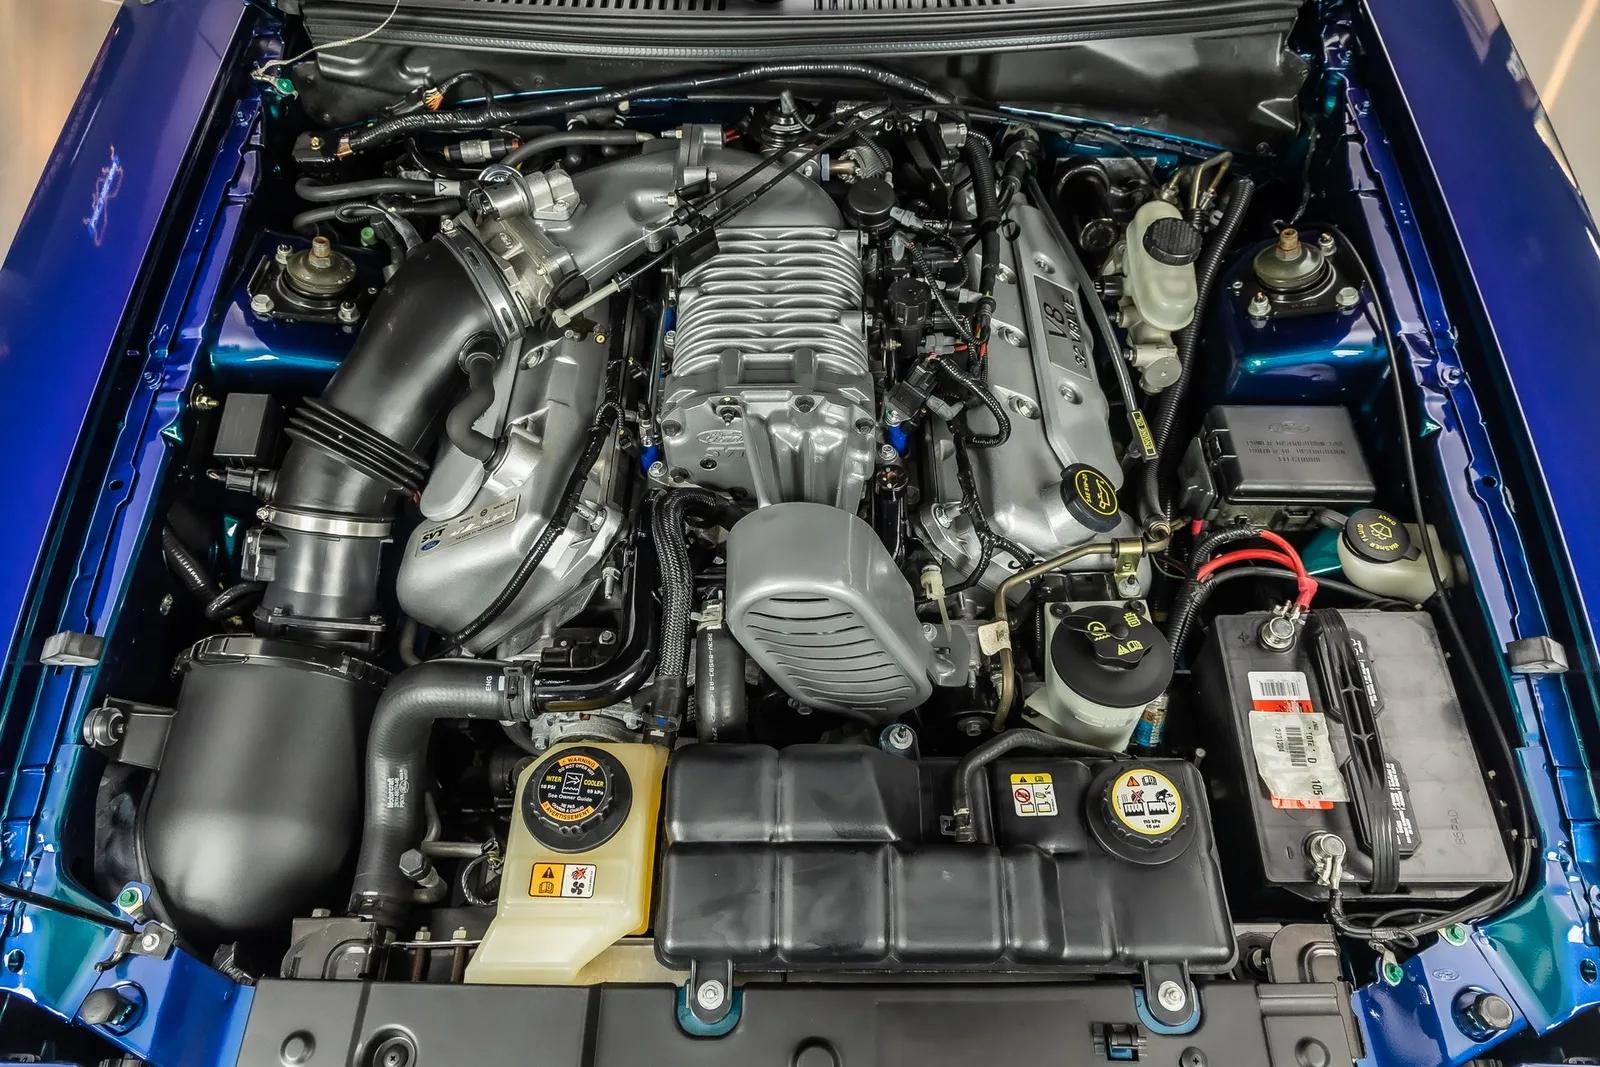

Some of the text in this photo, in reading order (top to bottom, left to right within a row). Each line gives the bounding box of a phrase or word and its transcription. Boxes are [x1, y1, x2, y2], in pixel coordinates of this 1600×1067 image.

[1043, 302, 1068, 339] V8
[1062, 295, 1087, 368] 32 VALVE
[1378, 514, 1397, 526] ONLY
[421, 528, 445, 543] SVT
[1356, 523, 1400, 552] WASHER FLUID
[485, 675, 493, 691] ENG
[568, 757, 596, 768] WARNING
[546, 775, 604, 787] INTER COOLER
[1311, 780, 1323, 796] 105
[547, 808, 591, 820] AVERTISSEMENT
